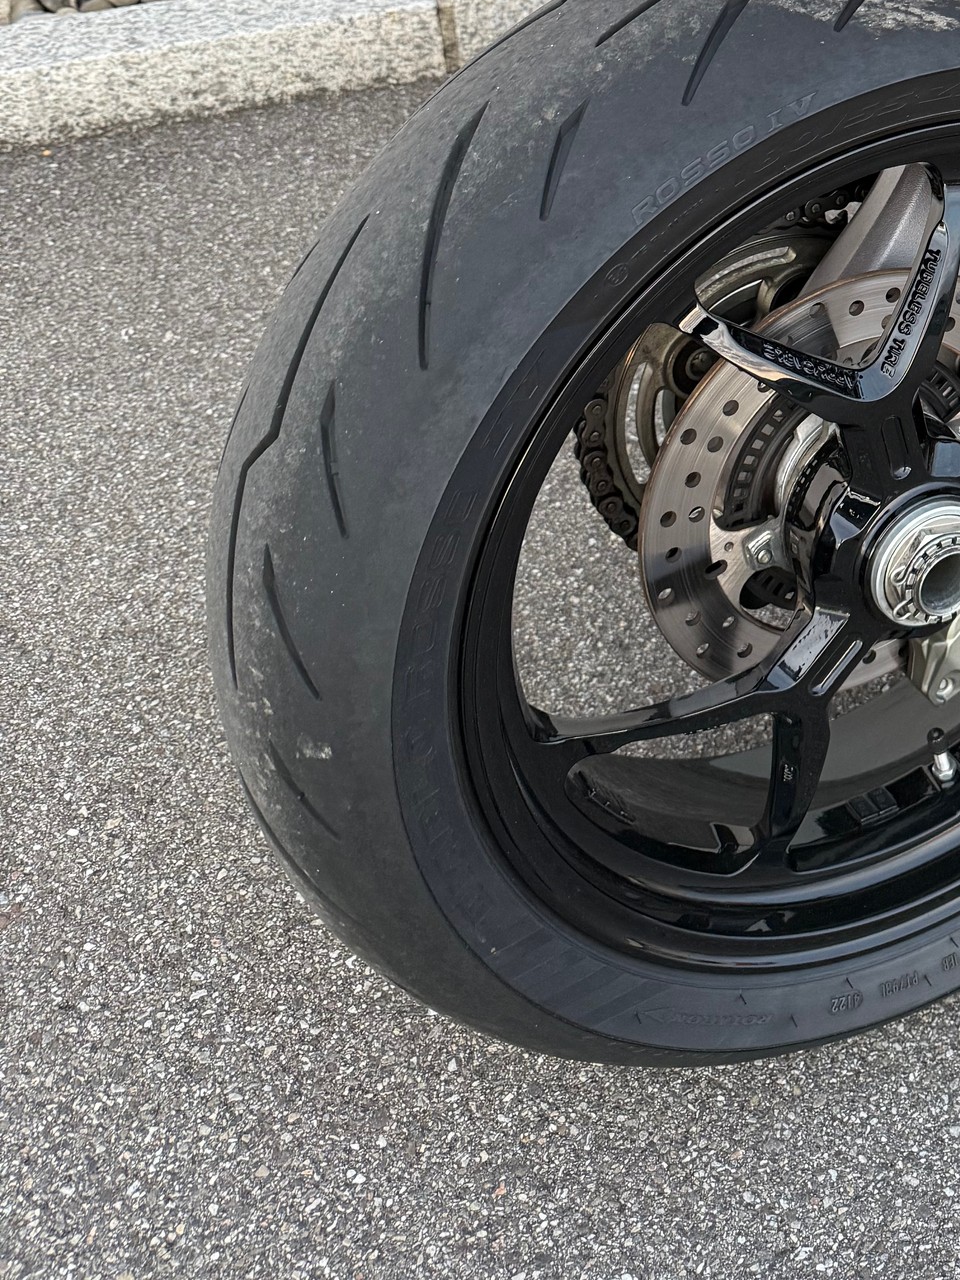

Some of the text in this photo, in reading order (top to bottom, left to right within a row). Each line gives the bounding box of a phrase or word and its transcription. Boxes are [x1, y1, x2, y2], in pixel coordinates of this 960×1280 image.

[631, 90, 819, 226] ROSSO IV
[880, 248, 942, 378] TUBELESS TIRE
